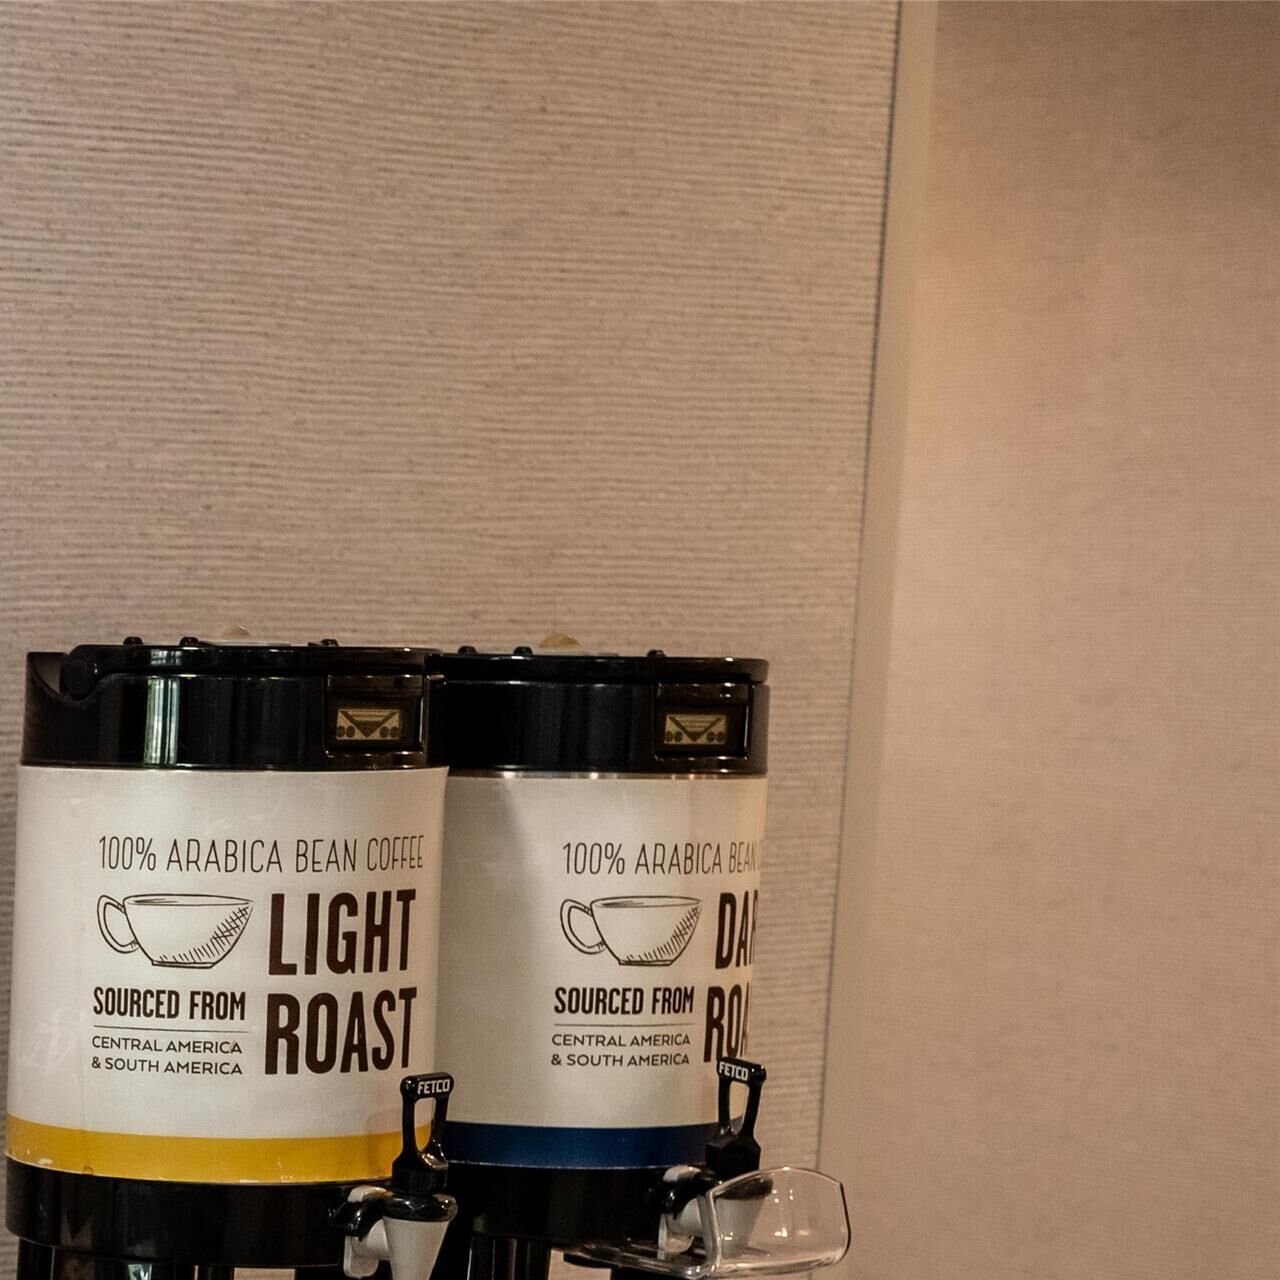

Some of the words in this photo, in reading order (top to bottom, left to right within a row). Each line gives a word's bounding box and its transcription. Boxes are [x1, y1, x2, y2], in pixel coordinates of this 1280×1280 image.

[99, 835, 157, 871] 100%
[166, 838, 283, 874] ARABICA
[295, 838, 358, 873] BEAN
[367, 834, 425, 872] COFFEE
[562, 842, 626, 875] 100%
[634, 842, 722, 875] ARABICA
[268, 887, 417, 976] LIGHT
[93, 986, 180, 1019] SOURCED
[189, 990, 246, 1021] FROM
[553, 986, 645, 1015] SOURCED
[651, 985, 695, 1015] FROM
[264, 986, 418, 1077] ROAST
[551, 1033, 627, 1047] CENTRAL
[629, 1033, 691, 1047] AMERICA
[91, 1035, 163, 1052] CENTRAL
[165, 1040, 243, 1055] AMERICA
[91, 1056, 101, 1070] &
[104, 1056, 160, 1073] SOUTH
[163, 1061, 243, 1075] AMERICA
[550, 1053, 562, 1066] &
[566, 1053, 624, 1067] SOUTH
[627, 1052, 690, 1067] AMERICA
[719, 1061, 749, 1081] FETCO
[417, 1079, 450, 1095] FETCO
